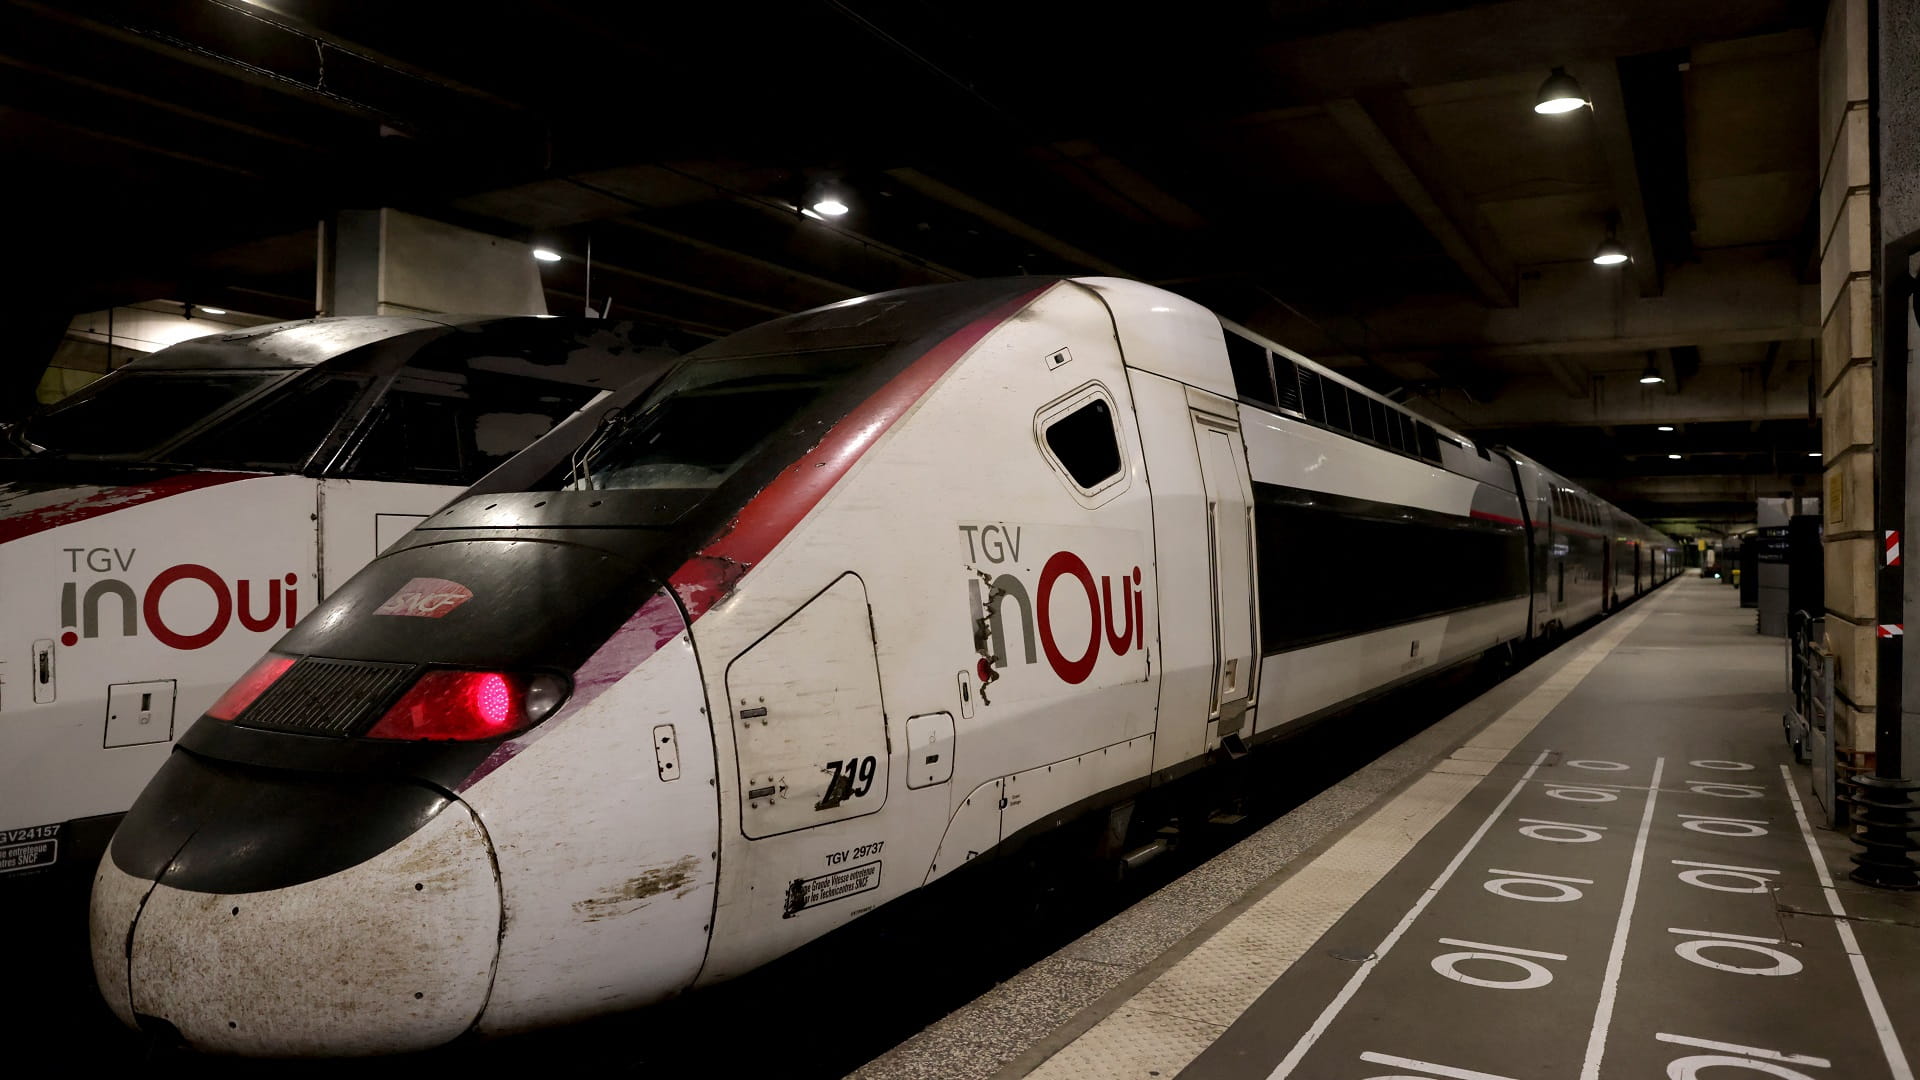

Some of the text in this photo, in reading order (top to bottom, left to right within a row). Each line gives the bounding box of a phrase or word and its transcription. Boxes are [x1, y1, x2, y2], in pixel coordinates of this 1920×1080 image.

[958, 524, 1021, 564] TGV
[63, 548, 136, 573] TGV
[815, 755, 877, 812] 719
[18, 853, 38, 866] SNCF
[826, 841, 885, 866] TGV 29737
[810, 891, 819, 902] les
[855, 876, 869, 890] SNCF
[811, 876, 831, 893] Grande
[831, 873, 850, 888] Vitesse
